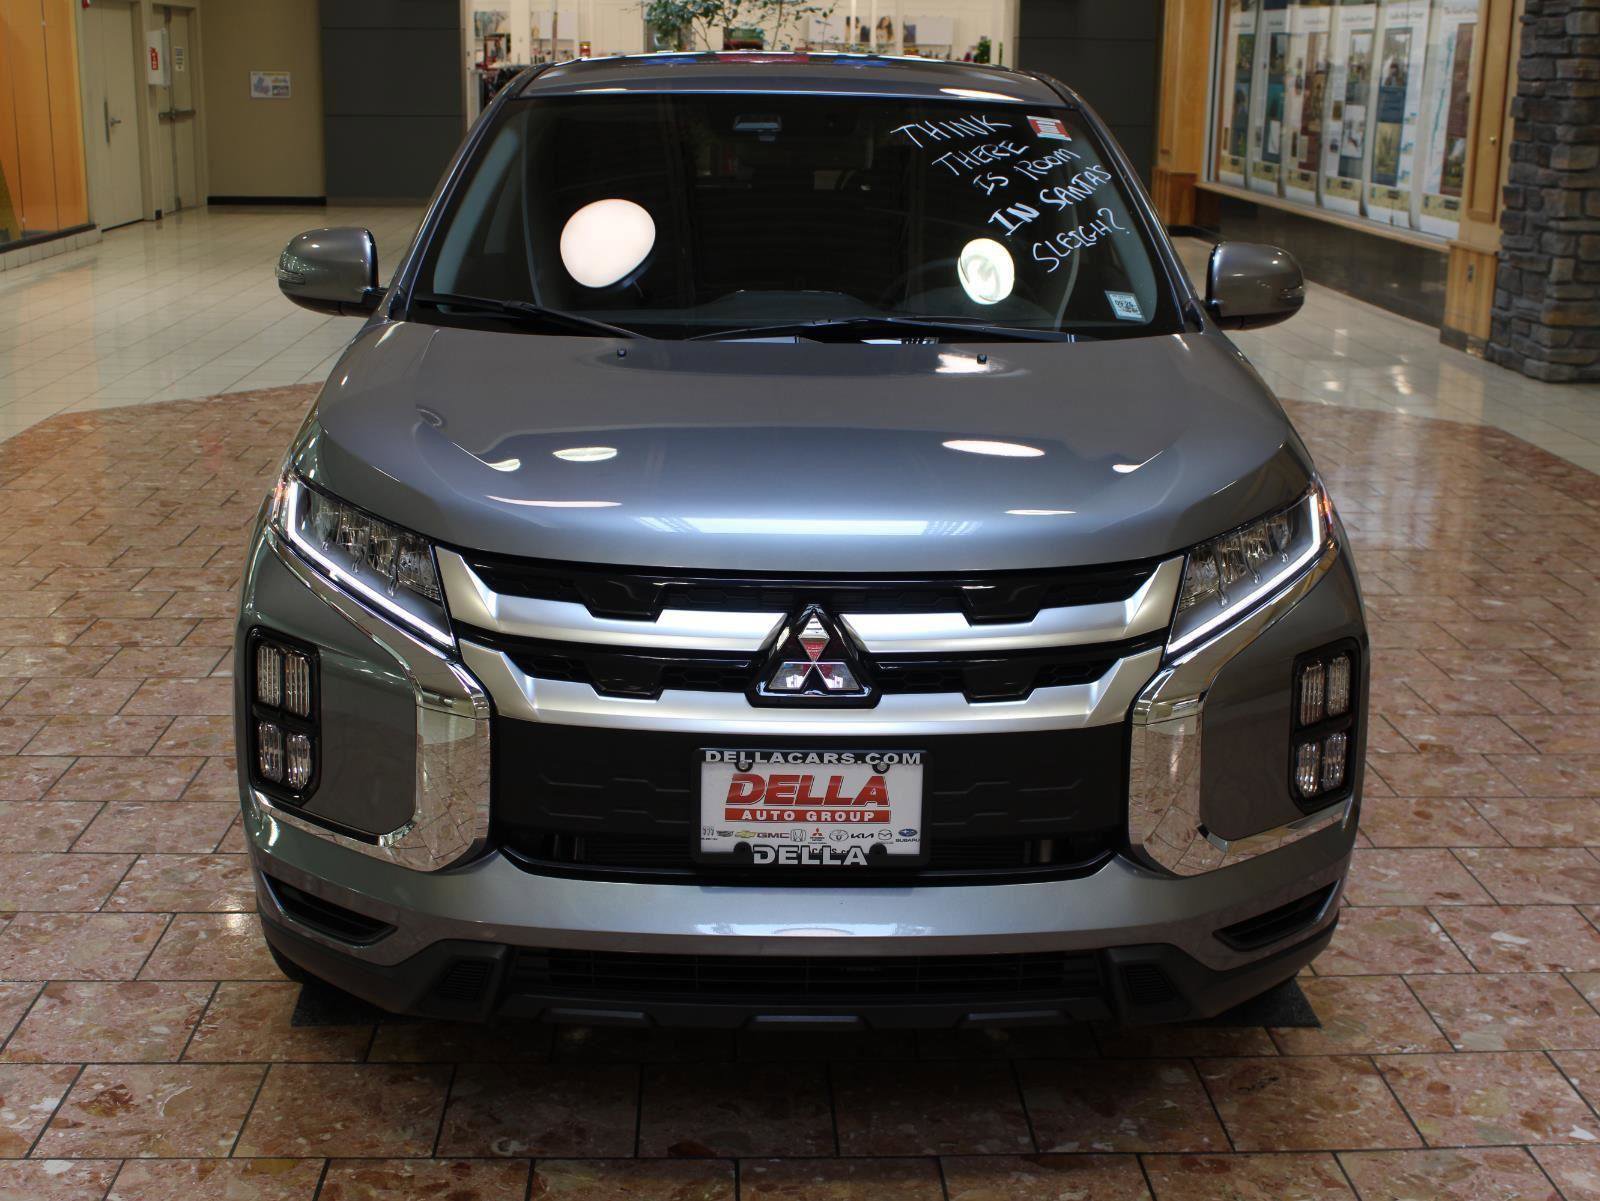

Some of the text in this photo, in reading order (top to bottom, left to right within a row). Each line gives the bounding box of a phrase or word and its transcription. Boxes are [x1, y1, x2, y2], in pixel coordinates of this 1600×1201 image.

[890, 115, 1012, 148] THINK
[932, 141, 1029, 176] THERE
[973, 148, 1081, 195] IS ROOM
[988, 165, 1112, 236] IN SANTAS
[1032, 208, 1130, 272] SLEIGH?
[705, 751, 921, 764] DELLACARS.COM
[726, 774, 891, 806] DELLA
[742, 811, 875, 822] AUTO GROUP
[753, 846, 868, 865] DELLA
